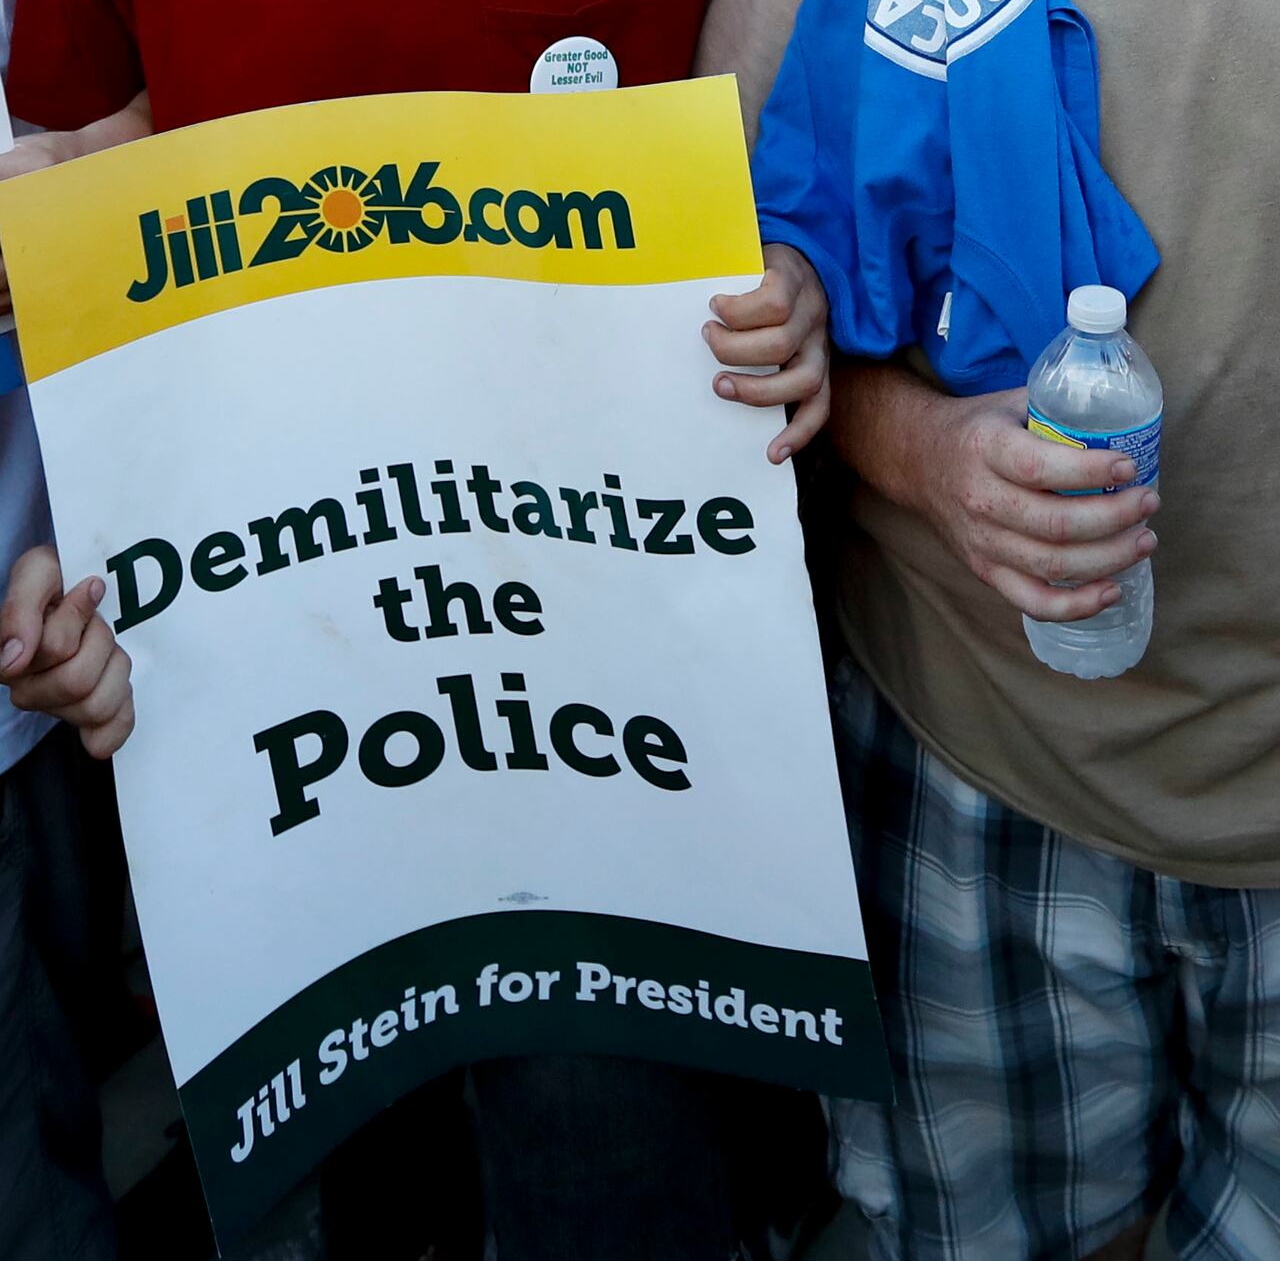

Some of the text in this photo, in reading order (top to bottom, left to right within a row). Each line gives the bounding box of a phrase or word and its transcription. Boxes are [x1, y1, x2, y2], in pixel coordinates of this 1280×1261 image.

[544, 49, 608, 63] Greater Good
[551, 71, 603, 86] Lesser Evil
[567, 62, 588, 74] NOT
[106, 459, 757, 634] Demilitarize
[372, 564, 545, 642] the
[252, 672, 693, 837] Police
[230, 961, 844, 1163] Jill Stein for President
